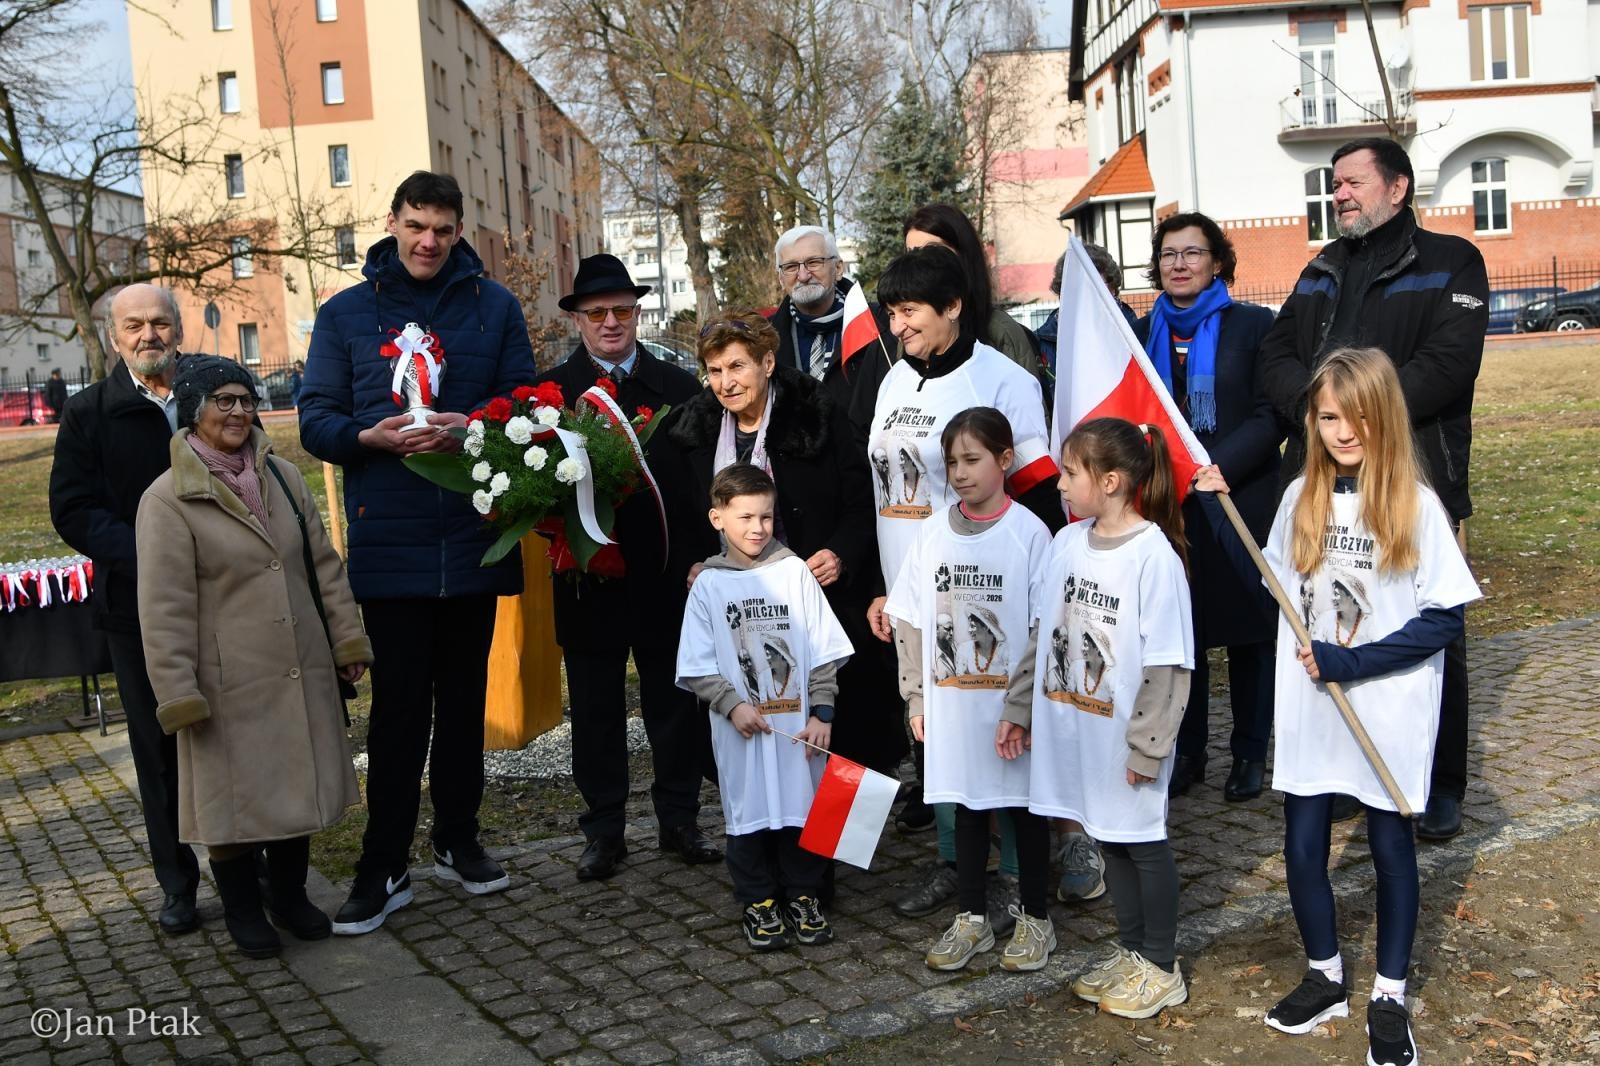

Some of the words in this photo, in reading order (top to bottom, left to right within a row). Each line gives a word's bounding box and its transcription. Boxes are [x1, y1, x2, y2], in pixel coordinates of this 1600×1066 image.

[897, 413, 937, 426] WILCZYM
[1325, 525, 1349, 535] ROPEM
[953, 564, 979, 573] TROPEM
[1354, 559, 1373, 570] 2026
[953, 573, 1003, 588] WILCZYM
[742, 598, 765, 607] TROPEM
[963, 593, 985, 602] EDYCJA
[986, 594, 1003, 602] 2026
[1077, 587, 1120, 611] WLCZYM
[744, 604, 789, 620] WILCZYM
[1102, 615, 1117, 626] 2026
[777, 623, 791, 631] 2026
